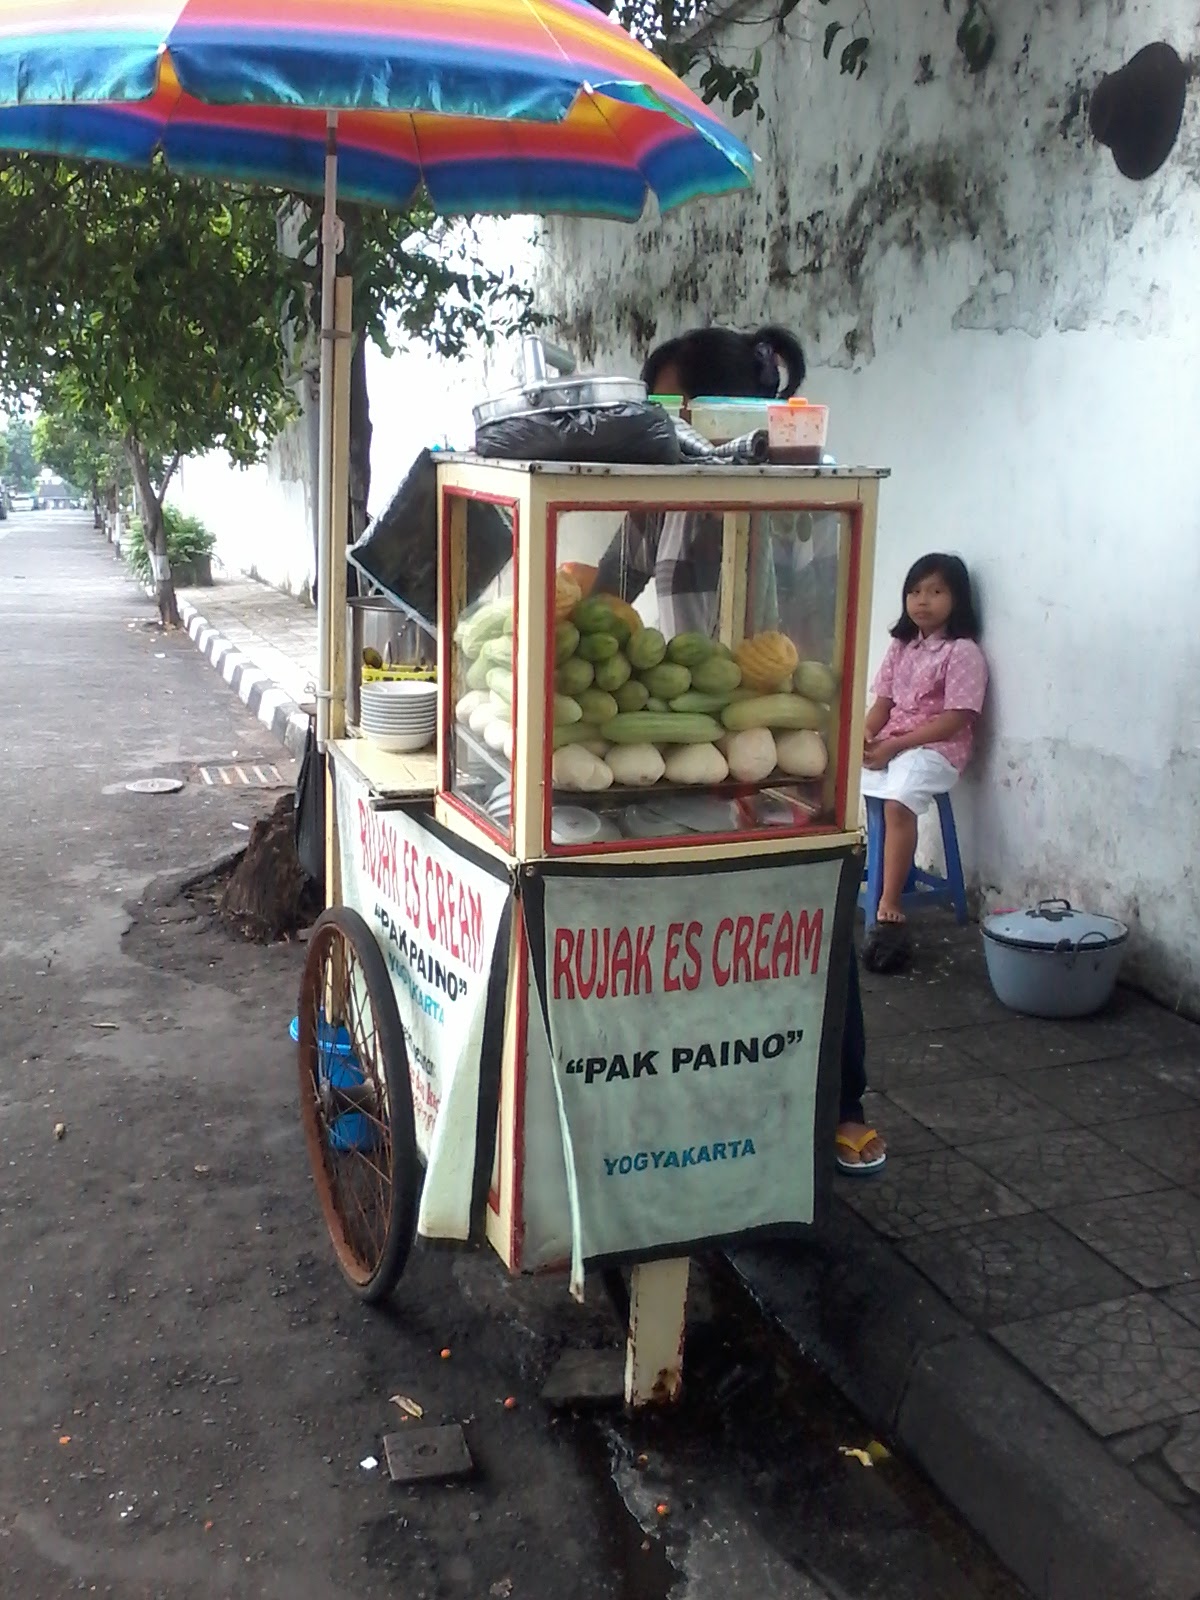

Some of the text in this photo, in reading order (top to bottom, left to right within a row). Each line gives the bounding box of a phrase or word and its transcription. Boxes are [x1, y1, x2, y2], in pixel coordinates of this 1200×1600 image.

[357, 797, 484, 975] RUJAK ES CREAM
[553, 908, 824, 1000] RUJAK ES CREAM
[566, 1029, 803, 1084] “PAK PAINO”
[604, 1138, 755, 1176] YOGYAKARTA
